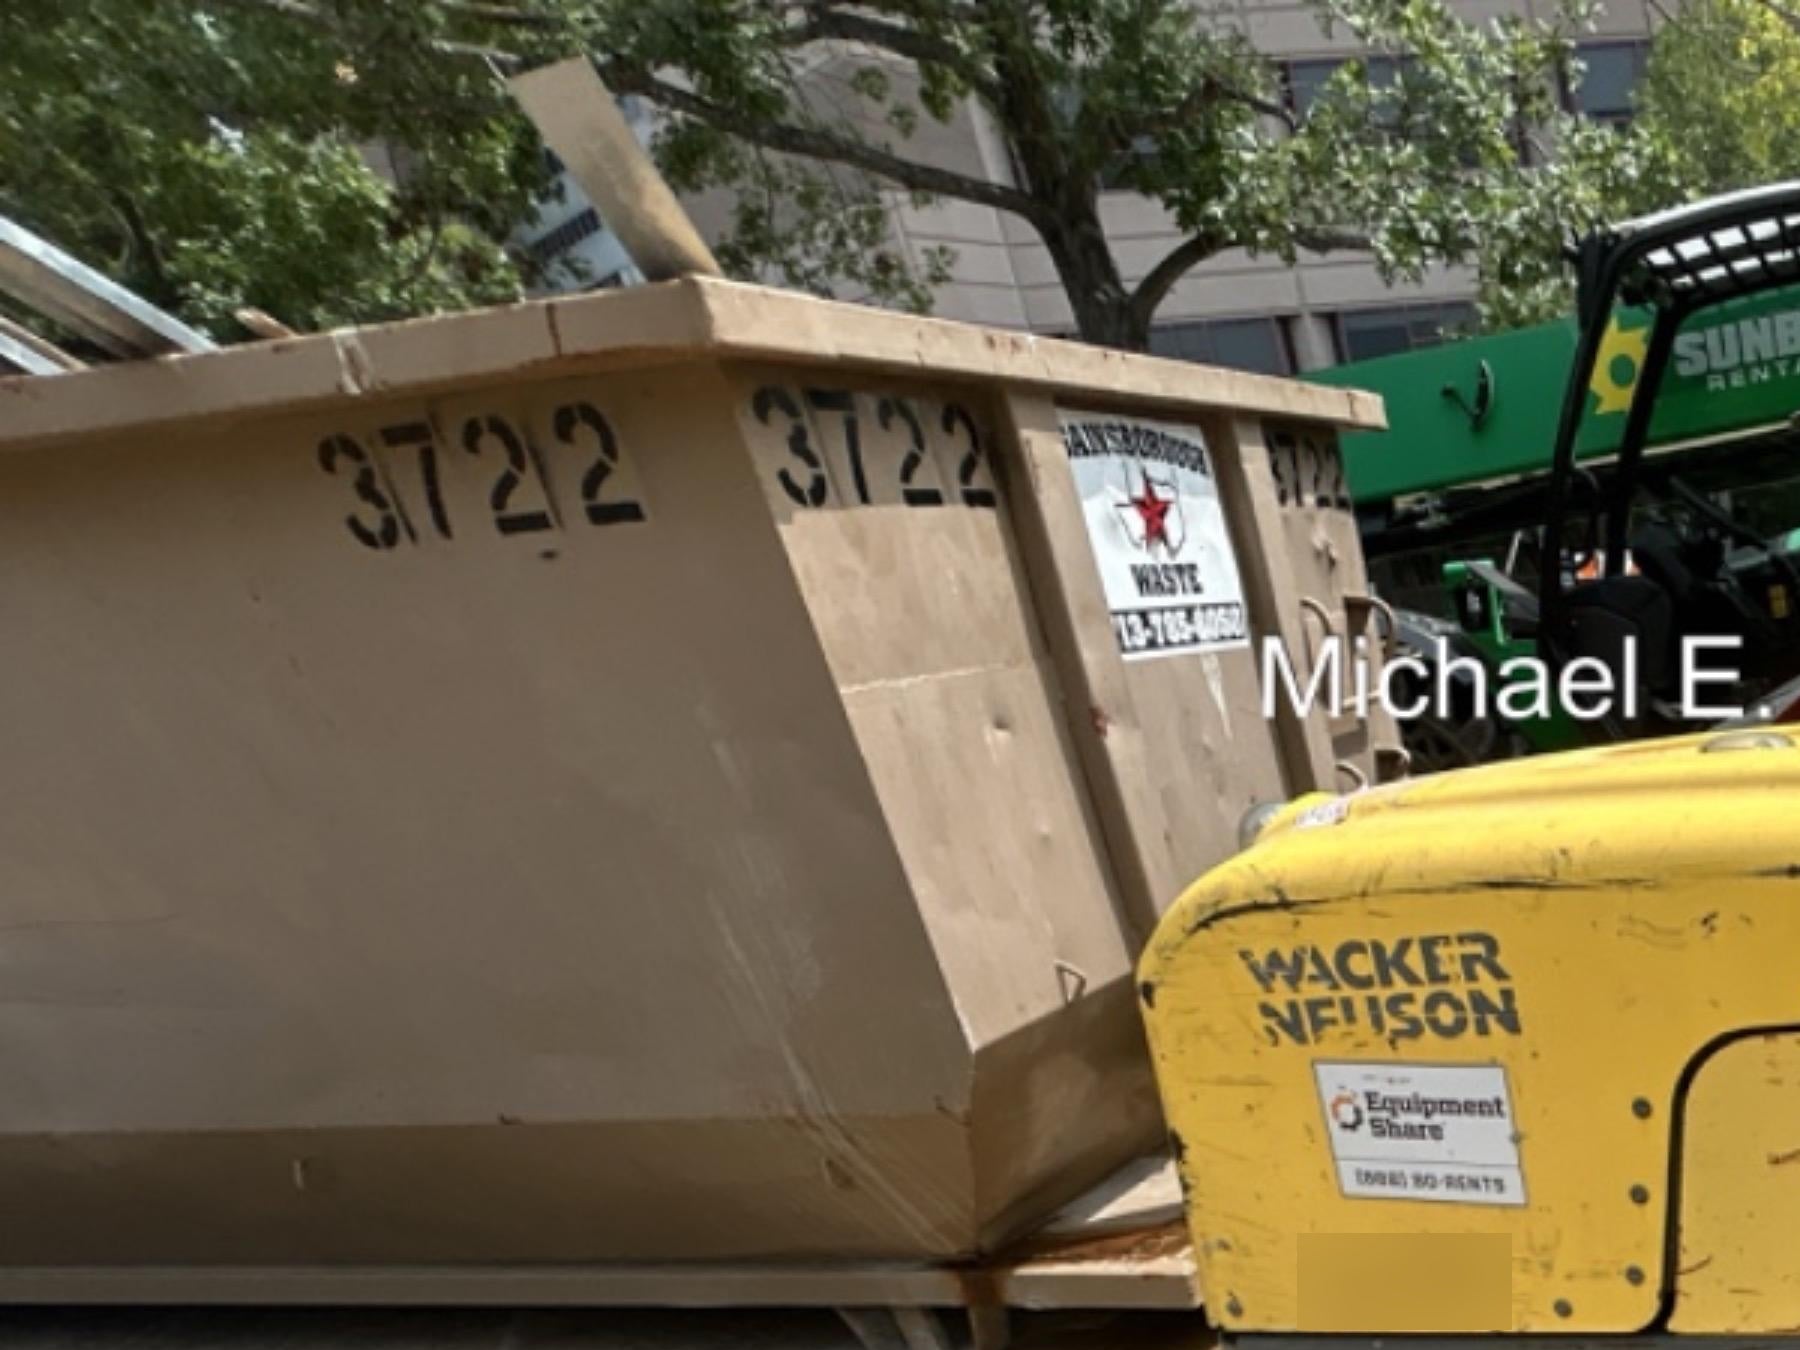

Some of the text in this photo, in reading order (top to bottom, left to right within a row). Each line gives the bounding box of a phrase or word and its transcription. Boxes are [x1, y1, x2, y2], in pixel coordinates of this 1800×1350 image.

[317, 401, 647, 549] 3722
[753, 386, 997, 508] 3722
[1130, 563, 1204, 598] WASTE
[1238, 932, 1512, 994] WACKER
[1258, 986, 1523, 1047] NEUSON
[1364, 1090, 1507, 1119] Equipment
[1368, 1117, 1446, 1141] Share
